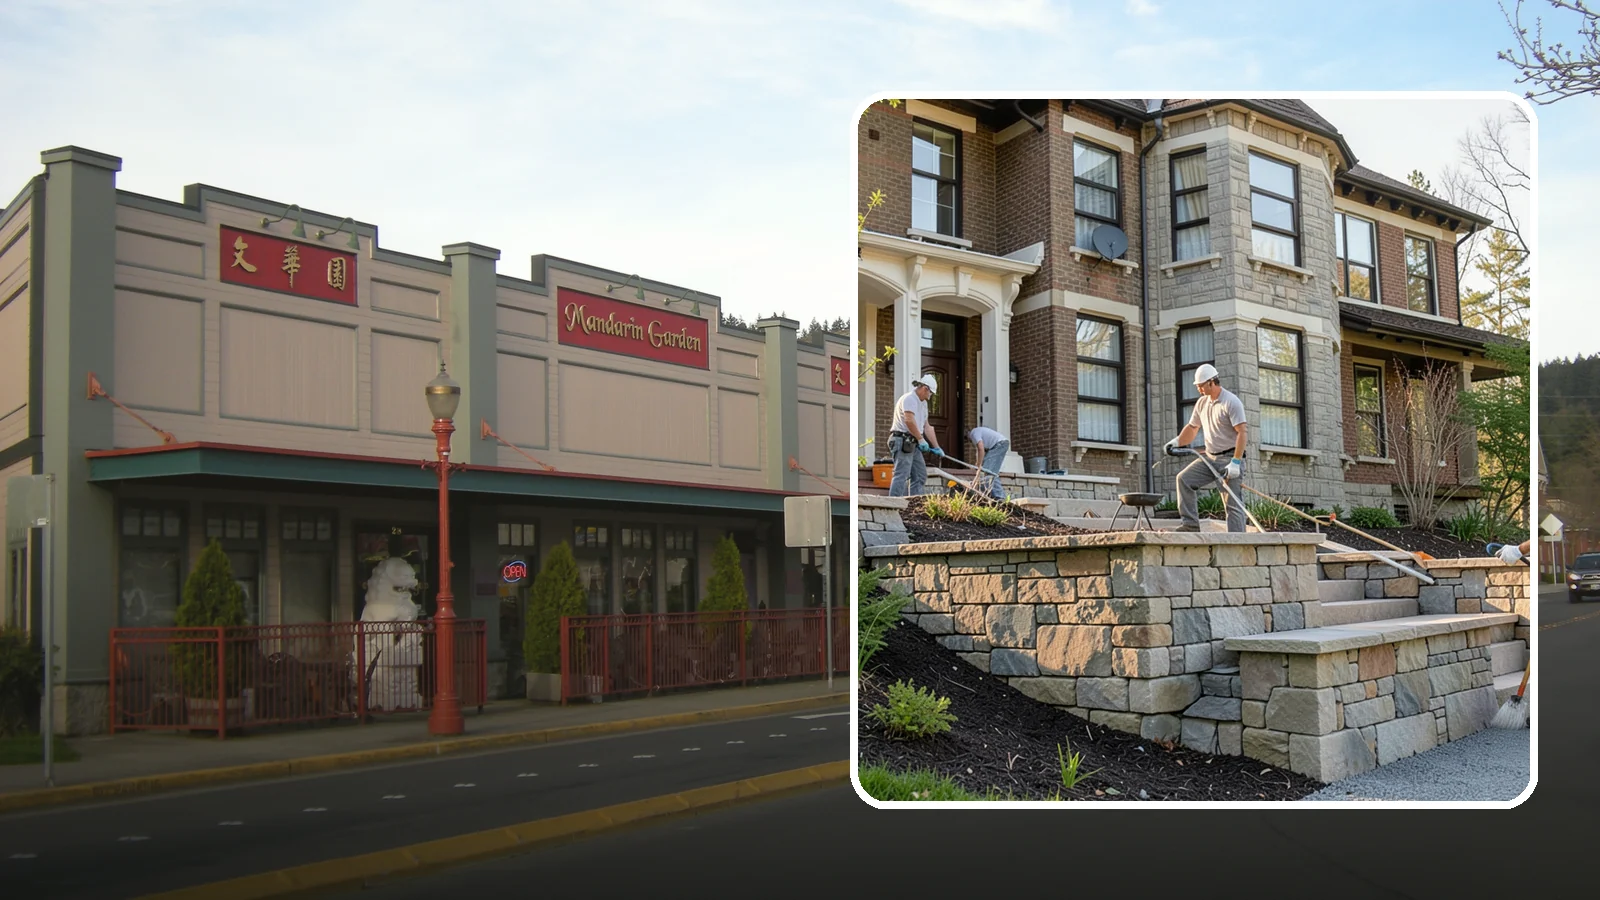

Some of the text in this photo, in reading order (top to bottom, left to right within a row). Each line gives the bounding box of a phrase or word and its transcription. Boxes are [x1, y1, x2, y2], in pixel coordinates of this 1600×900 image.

[231, 236, 346, 291] 文華園
[564, 302, 702, 352] Mandarin Garden
[834, 363, 846, 386] 文
[503, 565, 527, 578] OPEN
